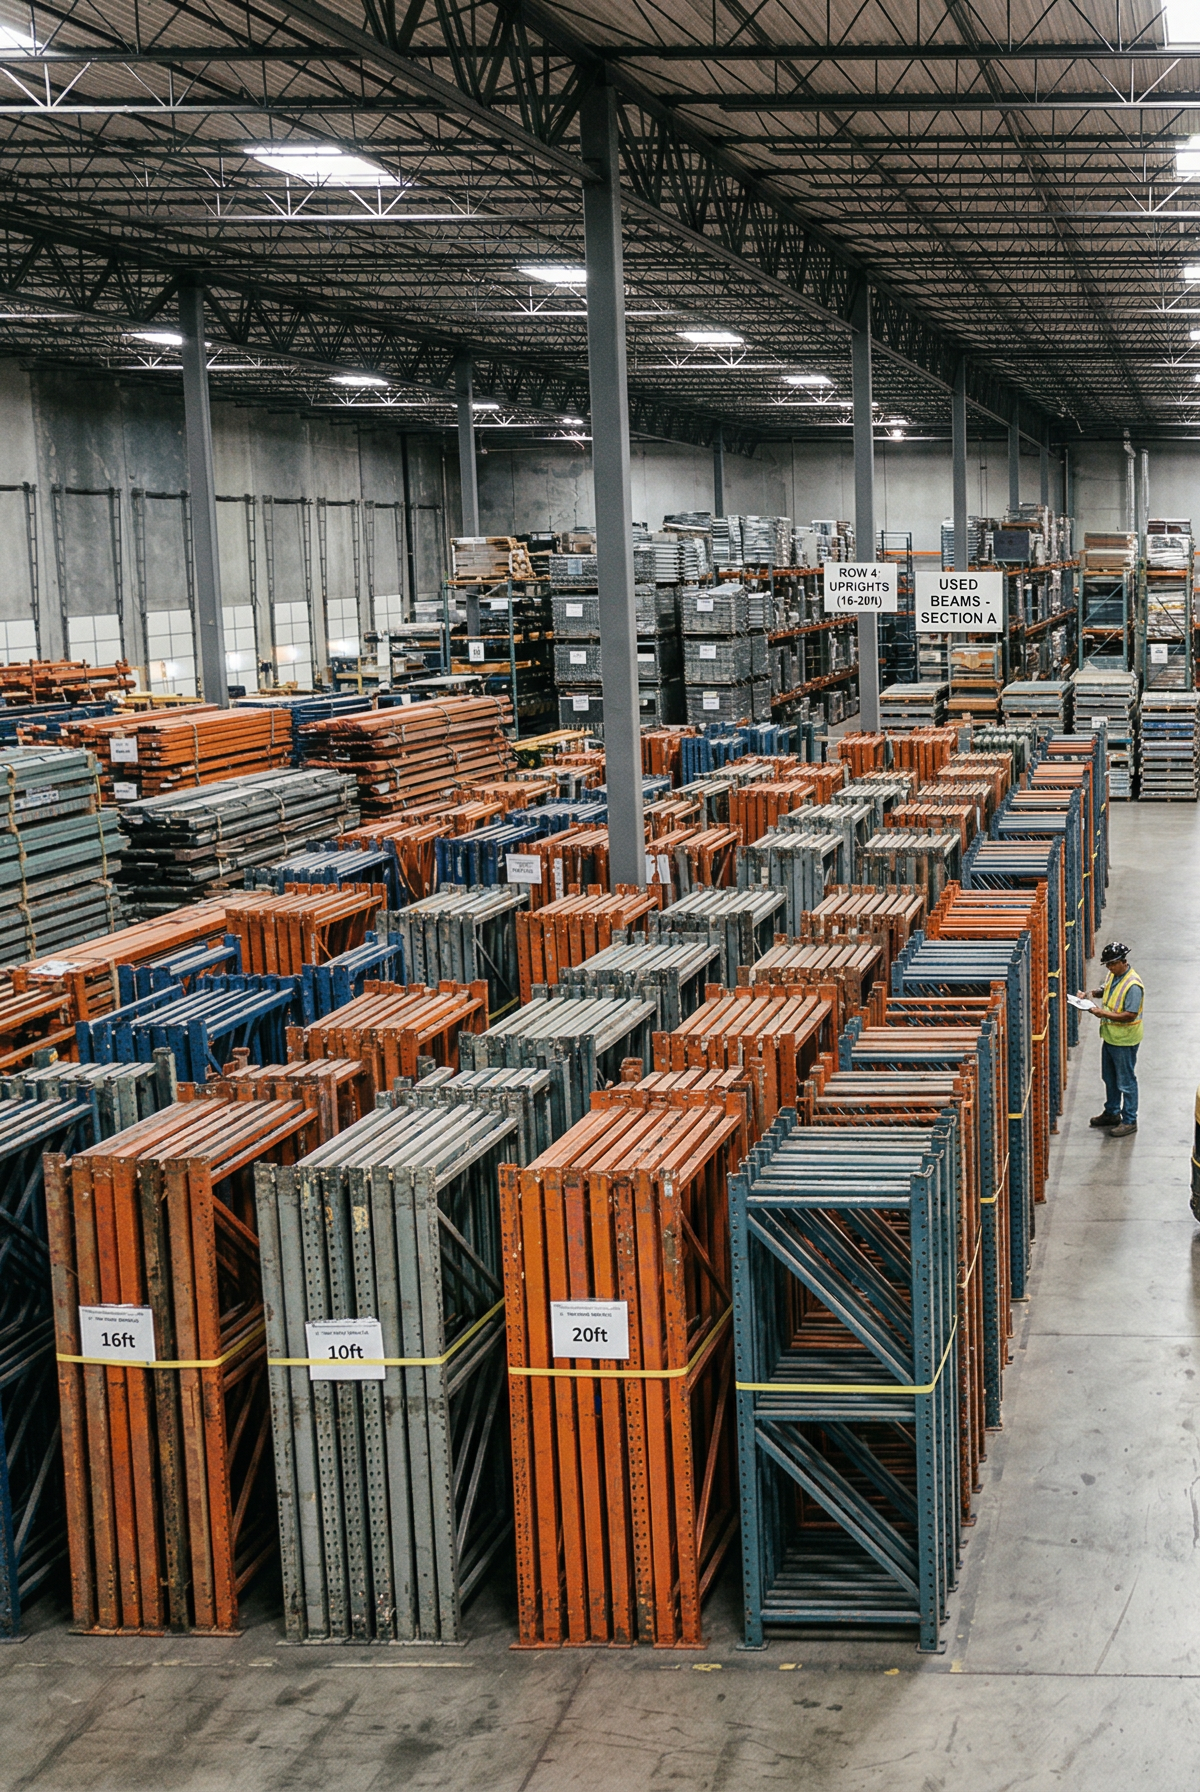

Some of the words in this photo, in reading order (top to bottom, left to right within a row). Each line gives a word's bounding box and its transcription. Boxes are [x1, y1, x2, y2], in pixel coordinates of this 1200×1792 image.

[839, 567, 868, 578] ROW
[829, 581, 890, 592] UPRIGHTS
[939, 578, 978, 590] USED
[930, 595, 981, 607] BEAMS
[921, 612, 983, 624] SECTION
[987, 612, 997, 624] A
[101, 1332, 136, 1348] 16ft
[572, 1326, 609, 1343] 20ft
[327, 1343, 364, 1360] 10ft
